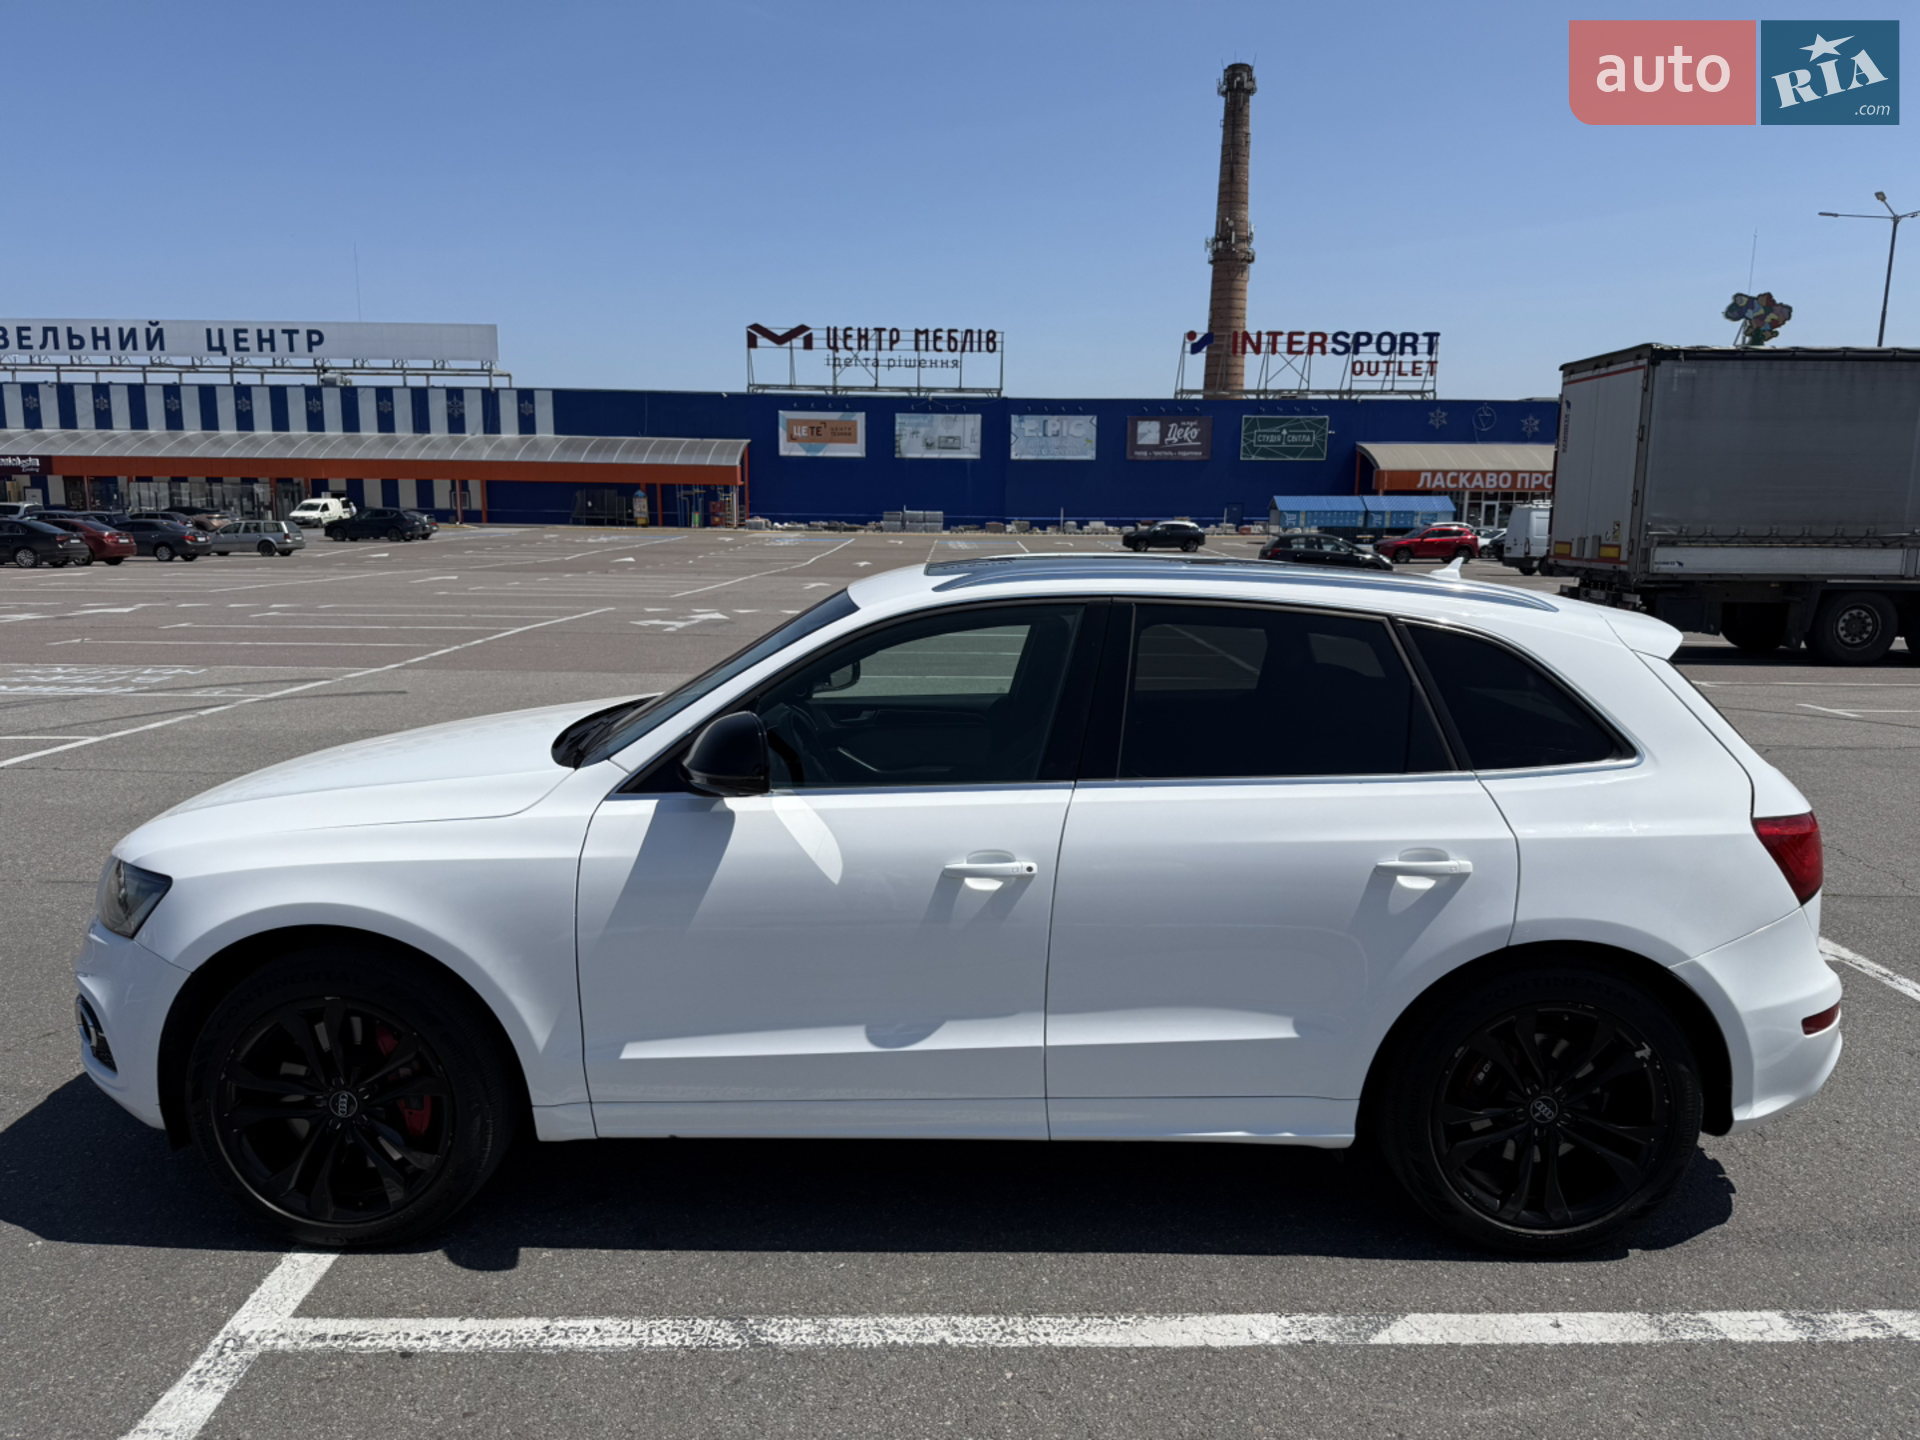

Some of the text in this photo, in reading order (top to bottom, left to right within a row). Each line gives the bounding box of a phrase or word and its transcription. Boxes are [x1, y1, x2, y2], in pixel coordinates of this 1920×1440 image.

[205, 327, 325, 356] ЦЕНТР
[826, 325, 997, 354] ЦЕНТР МЕБЛІВ
[1231, 330, 1440, 356] INTERSPORT
[887, 354, 960, 371] рішення
[1351, 360, 1439, 377] OUTLET
[793, 425, 823, 438] ЦЕТЕ
[1417, 471, 1512, 489] ЛАСКАВО
